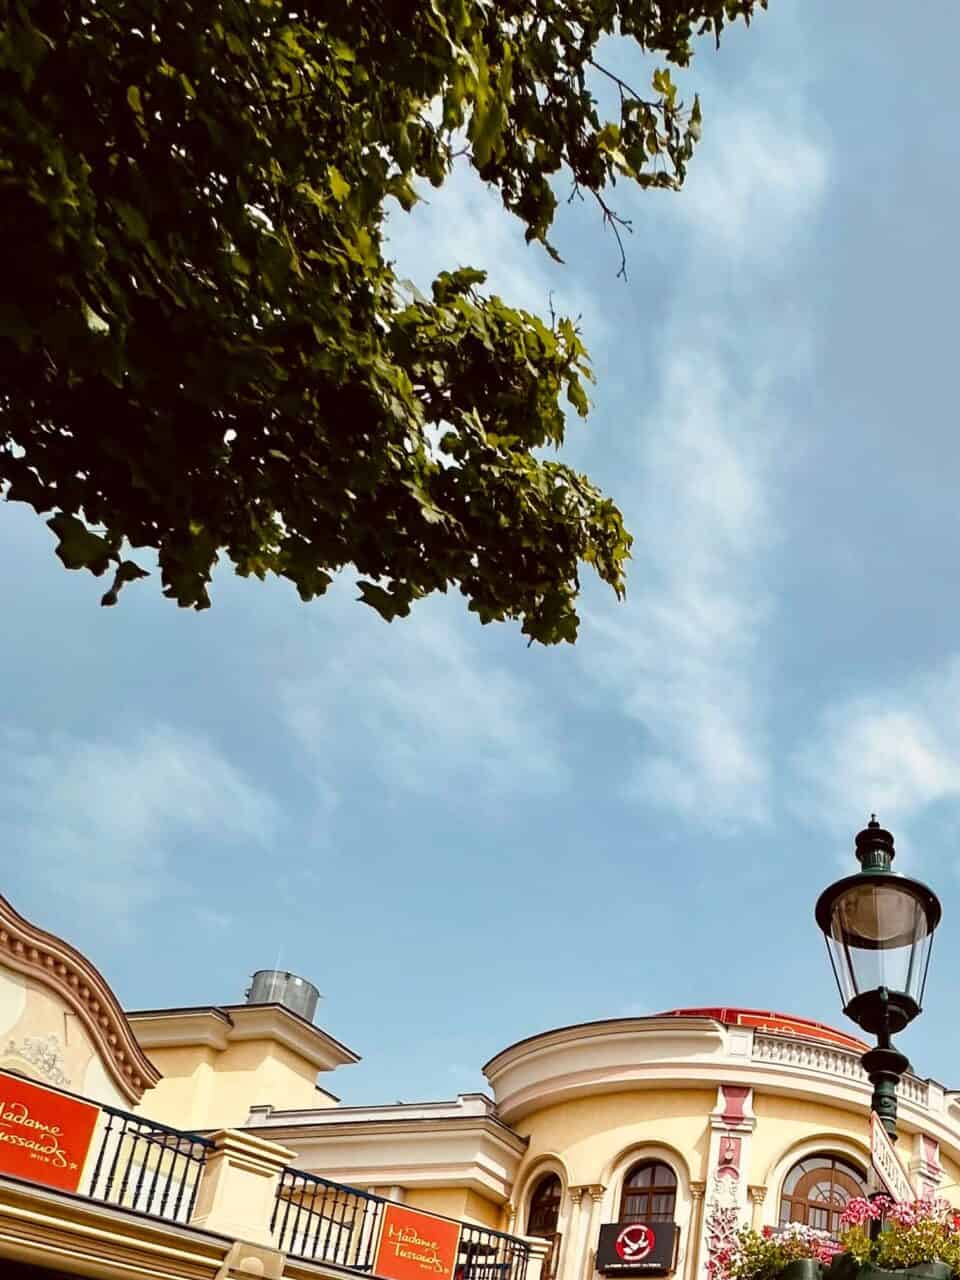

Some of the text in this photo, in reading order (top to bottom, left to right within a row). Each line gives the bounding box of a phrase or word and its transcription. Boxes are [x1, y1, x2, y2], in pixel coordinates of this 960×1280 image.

[0, 1122, 67, 1168] ussauds
[388, 1224, 440, 1250] Madame
[389, 1241, 443, 1273] Tussauds
